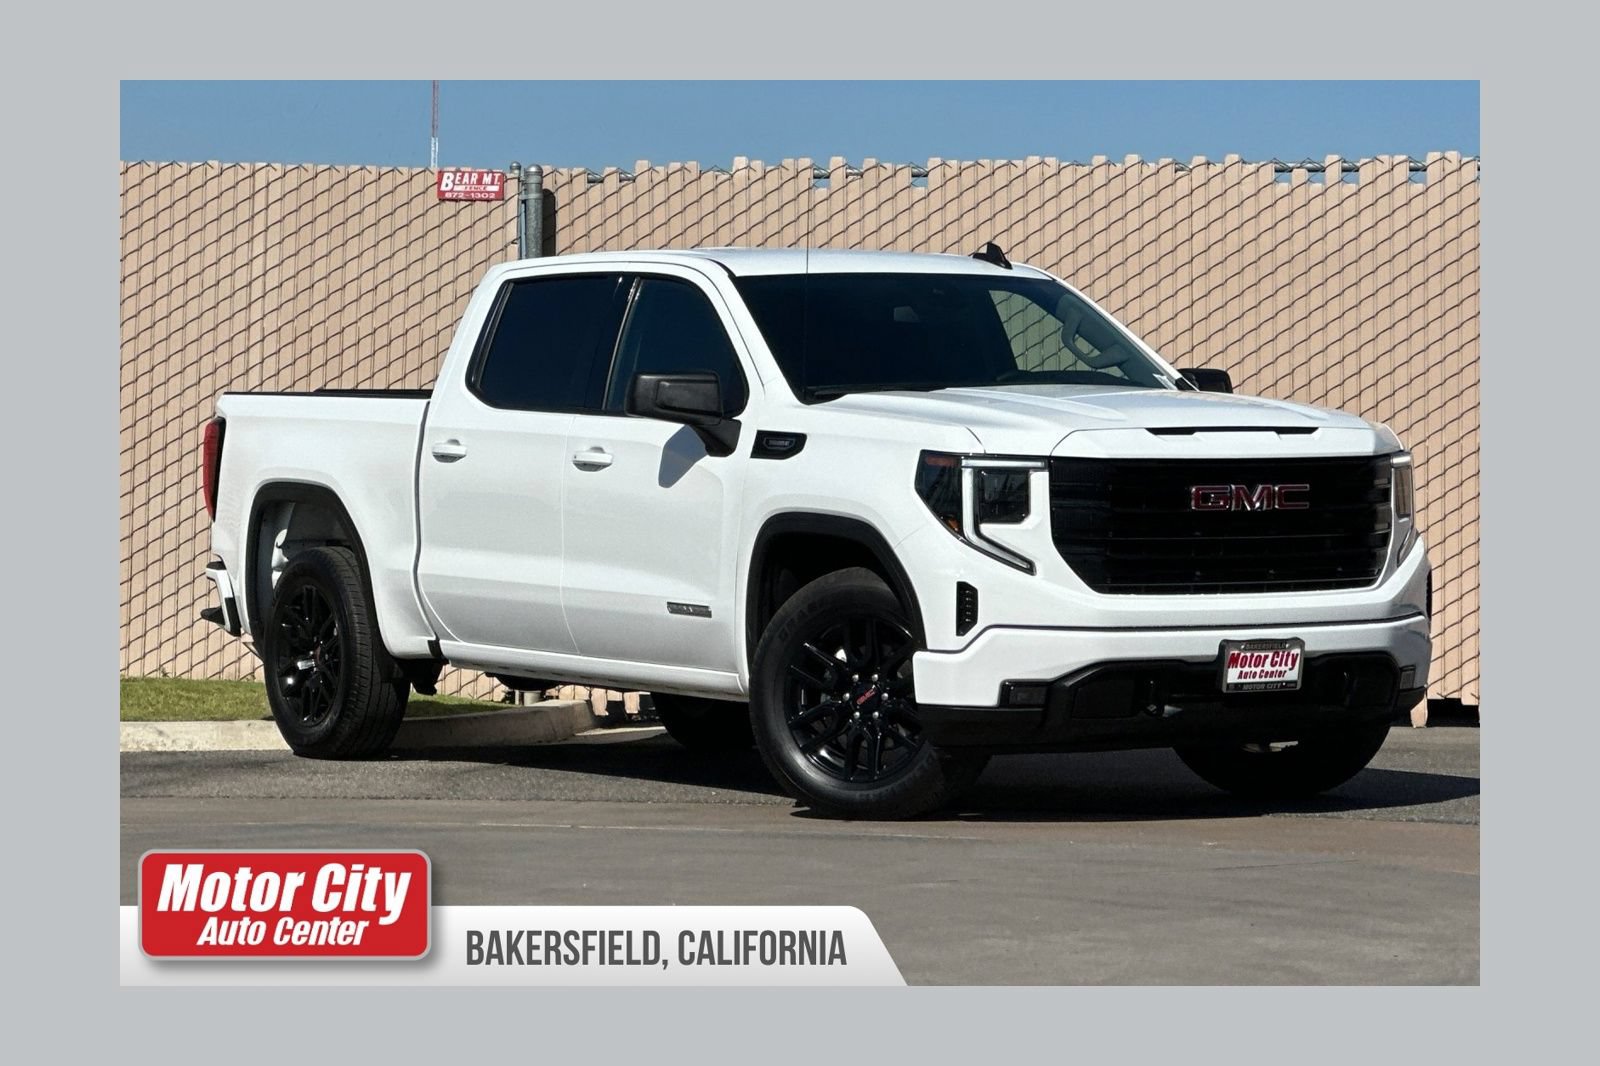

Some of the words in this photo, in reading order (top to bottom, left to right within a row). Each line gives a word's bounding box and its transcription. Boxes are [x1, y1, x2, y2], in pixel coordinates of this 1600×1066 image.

[440, 172, 478, 191] BEAR
[482, 173, 501, 185] MT.
[1191, 484, 1310, 511] GMC
[1227, 653, 1269, 669] Motor
[1270, 651, 1299, 671] City
[1238, 671, 1257, 680] Auto
[1258, 669, 1287, 679] Center
